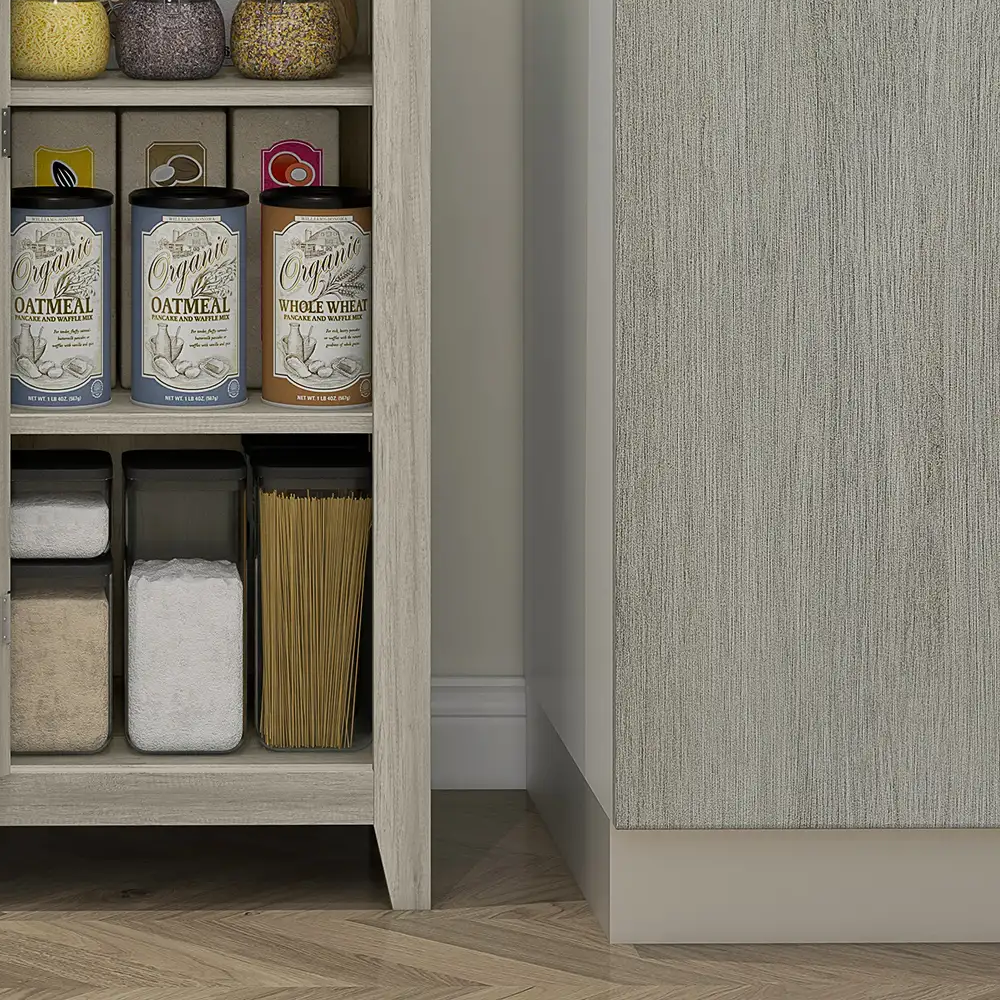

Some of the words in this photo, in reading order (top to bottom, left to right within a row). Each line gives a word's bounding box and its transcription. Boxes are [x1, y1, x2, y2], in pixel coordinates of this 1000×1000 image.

[12, 236, 93, 296] Organic
[148, 236, 228, 296] Organic
[280, 236, 361, 296] Organic
[14, 296, 93, 314] OATMEAL
[151, 296, 230, 314] OATMEAL
[279, 299, 324, 314] WHOLE
[326, 299, 367, 314] WHEAT
